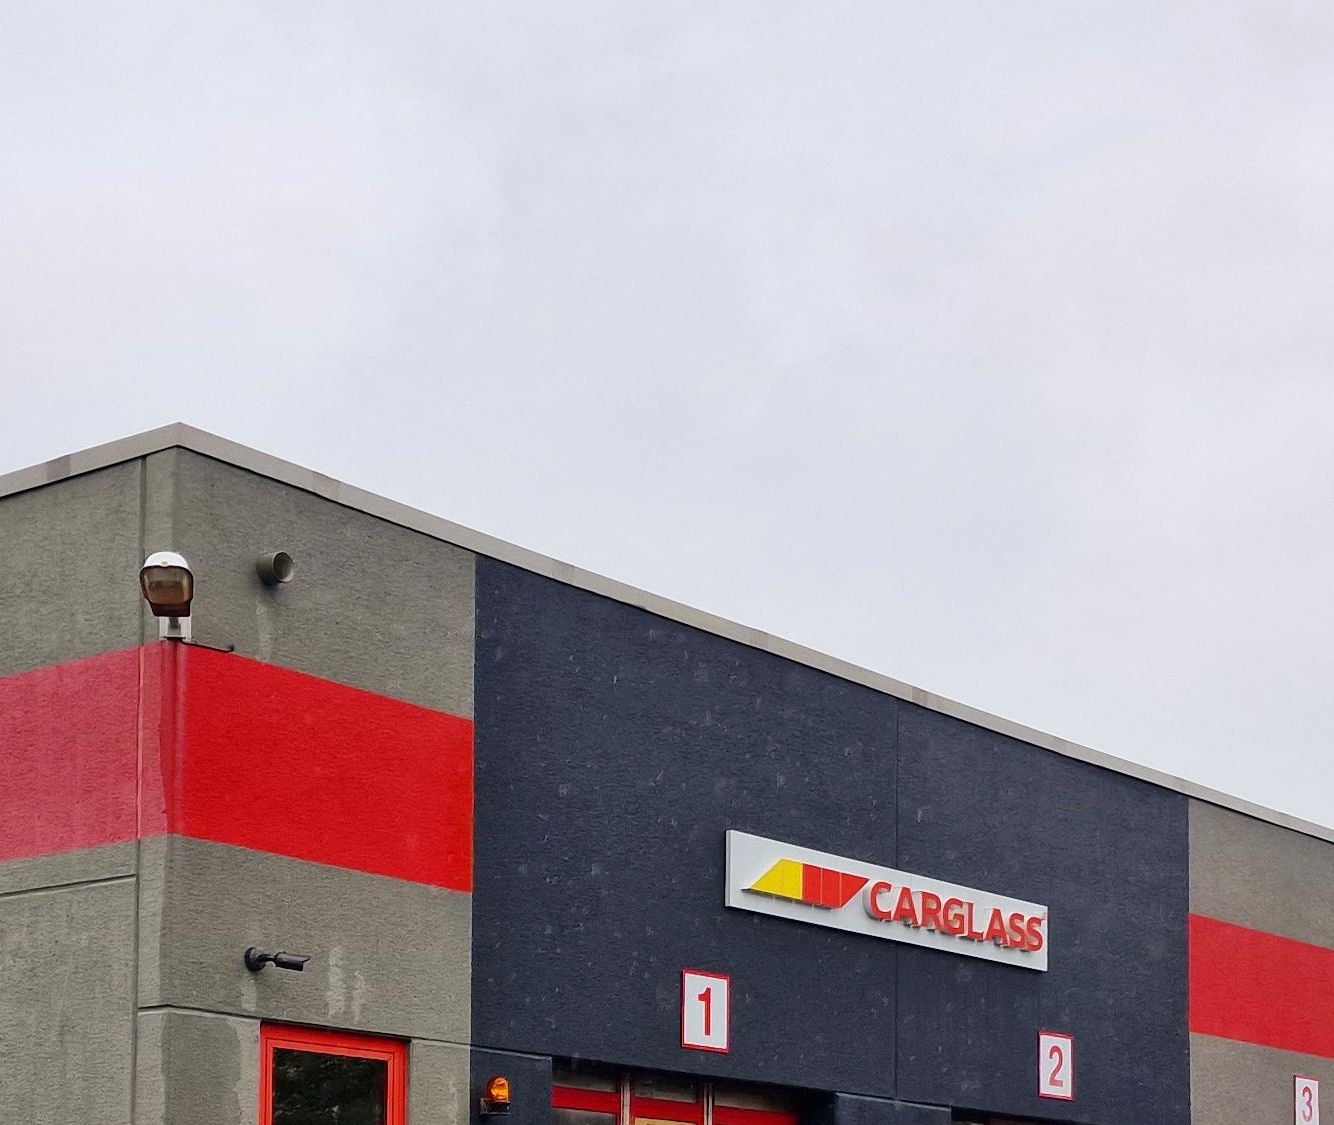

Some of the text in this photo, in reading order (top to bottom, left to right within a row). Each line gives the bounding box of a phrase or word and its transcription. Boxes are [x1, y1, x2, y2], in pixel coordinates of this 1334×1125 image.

[868, 881, 1044, 953] CARGLASS
[697, 986, 711, 1037] 1
[1049, 1045, 1064, 1087] 2
[1302, 1085, 1314, 1122] 3
